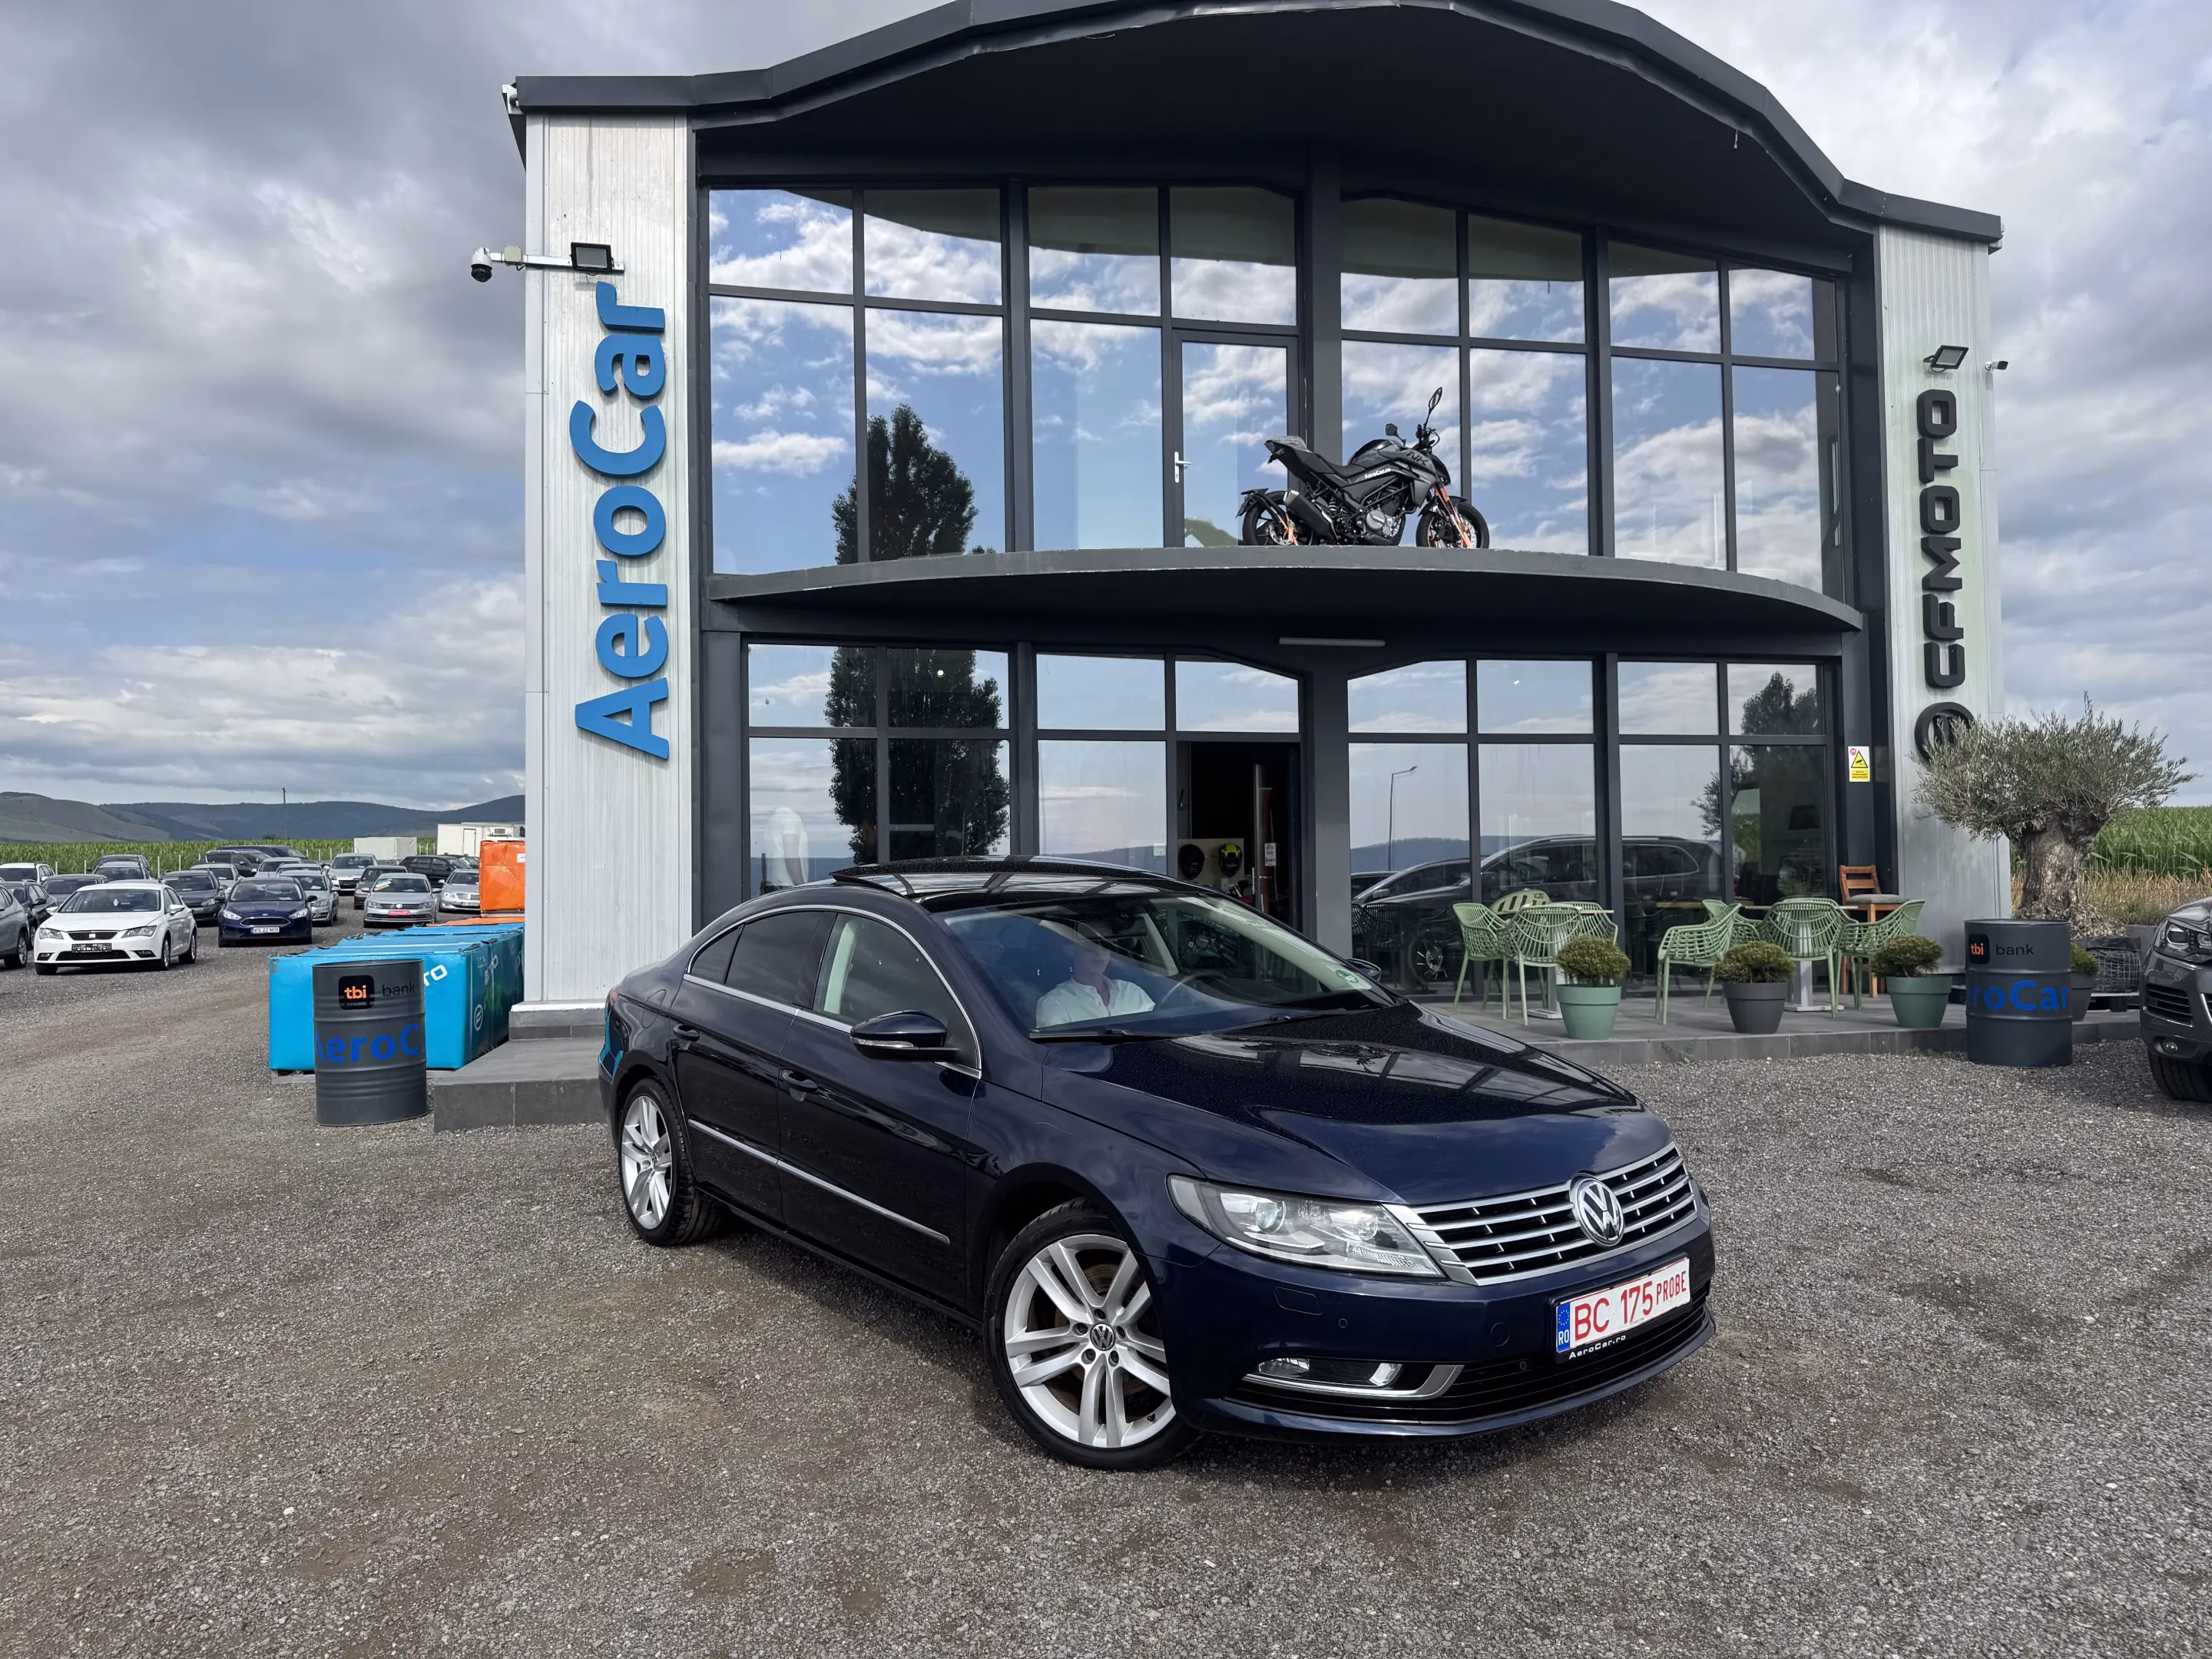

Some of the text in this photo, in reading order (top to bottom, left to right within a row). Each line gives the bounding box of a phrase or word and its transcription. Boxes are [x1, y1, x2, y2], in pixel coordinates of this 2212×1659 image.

[569, 280, 669, 760] AeroCar
[1916, 389, 1966, 689] CFMOTO
[1971, 943, 2035, 955] tbi bank
[344, 982, 416, 999] tbi bank
[1575, 1270, 1687, 1341] BC 175 PROBE
[1558, 1330, 1570, 1346] RO
[1568, 1335, 1627, 1359] AeroCar.ro
